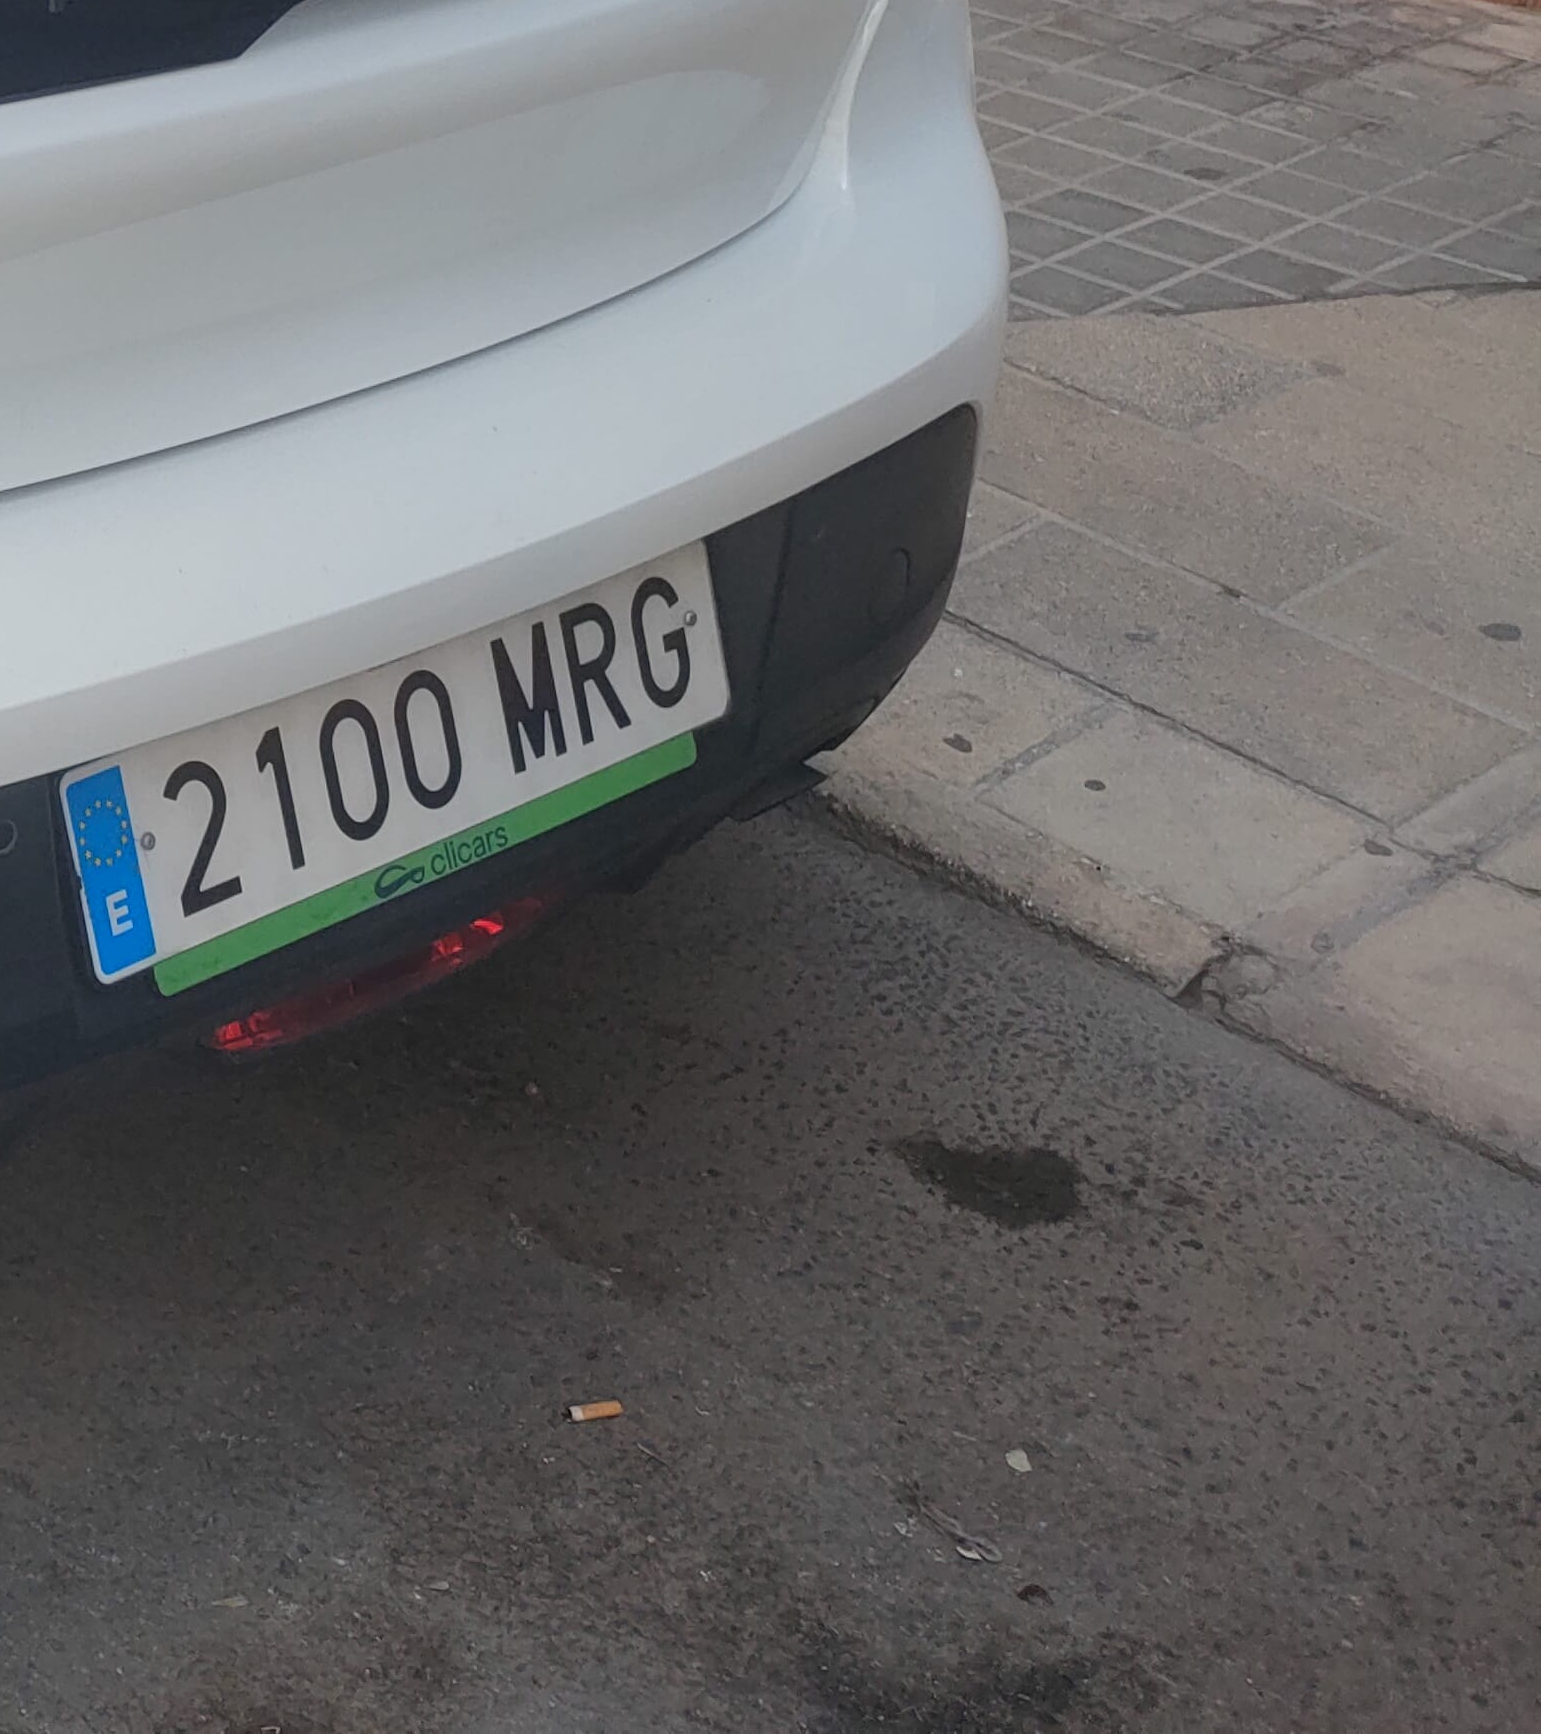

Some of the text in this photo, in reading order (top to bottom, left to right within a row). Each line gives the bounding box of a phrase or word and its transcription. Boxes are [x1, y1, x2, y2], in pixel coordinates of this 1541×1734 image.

[161, 576, 693, 917] 2100 MRG
[430, 824, 510, 877] clicars
[105, 888, 134, 936] E
